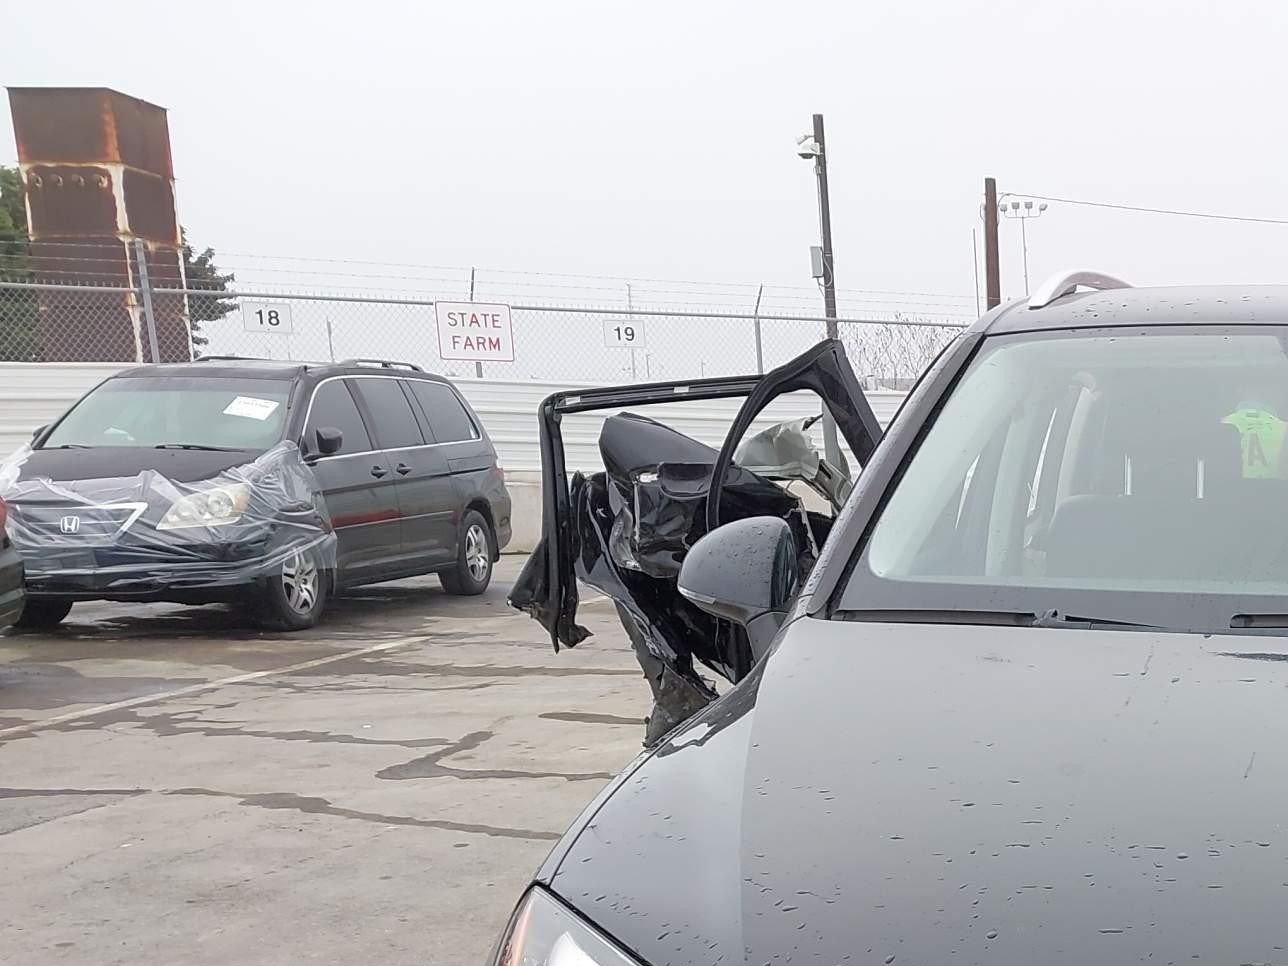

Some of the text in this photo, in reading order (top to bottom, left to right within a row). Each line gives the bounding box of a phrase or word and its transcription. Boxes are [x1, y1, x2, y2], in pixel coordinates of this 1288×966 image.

[255, 309, 280, 326] 18
[447, 311, 502, 329] STATE
[613, 326, 635, 341] 19
[452, 335, 501, 352] FARM
